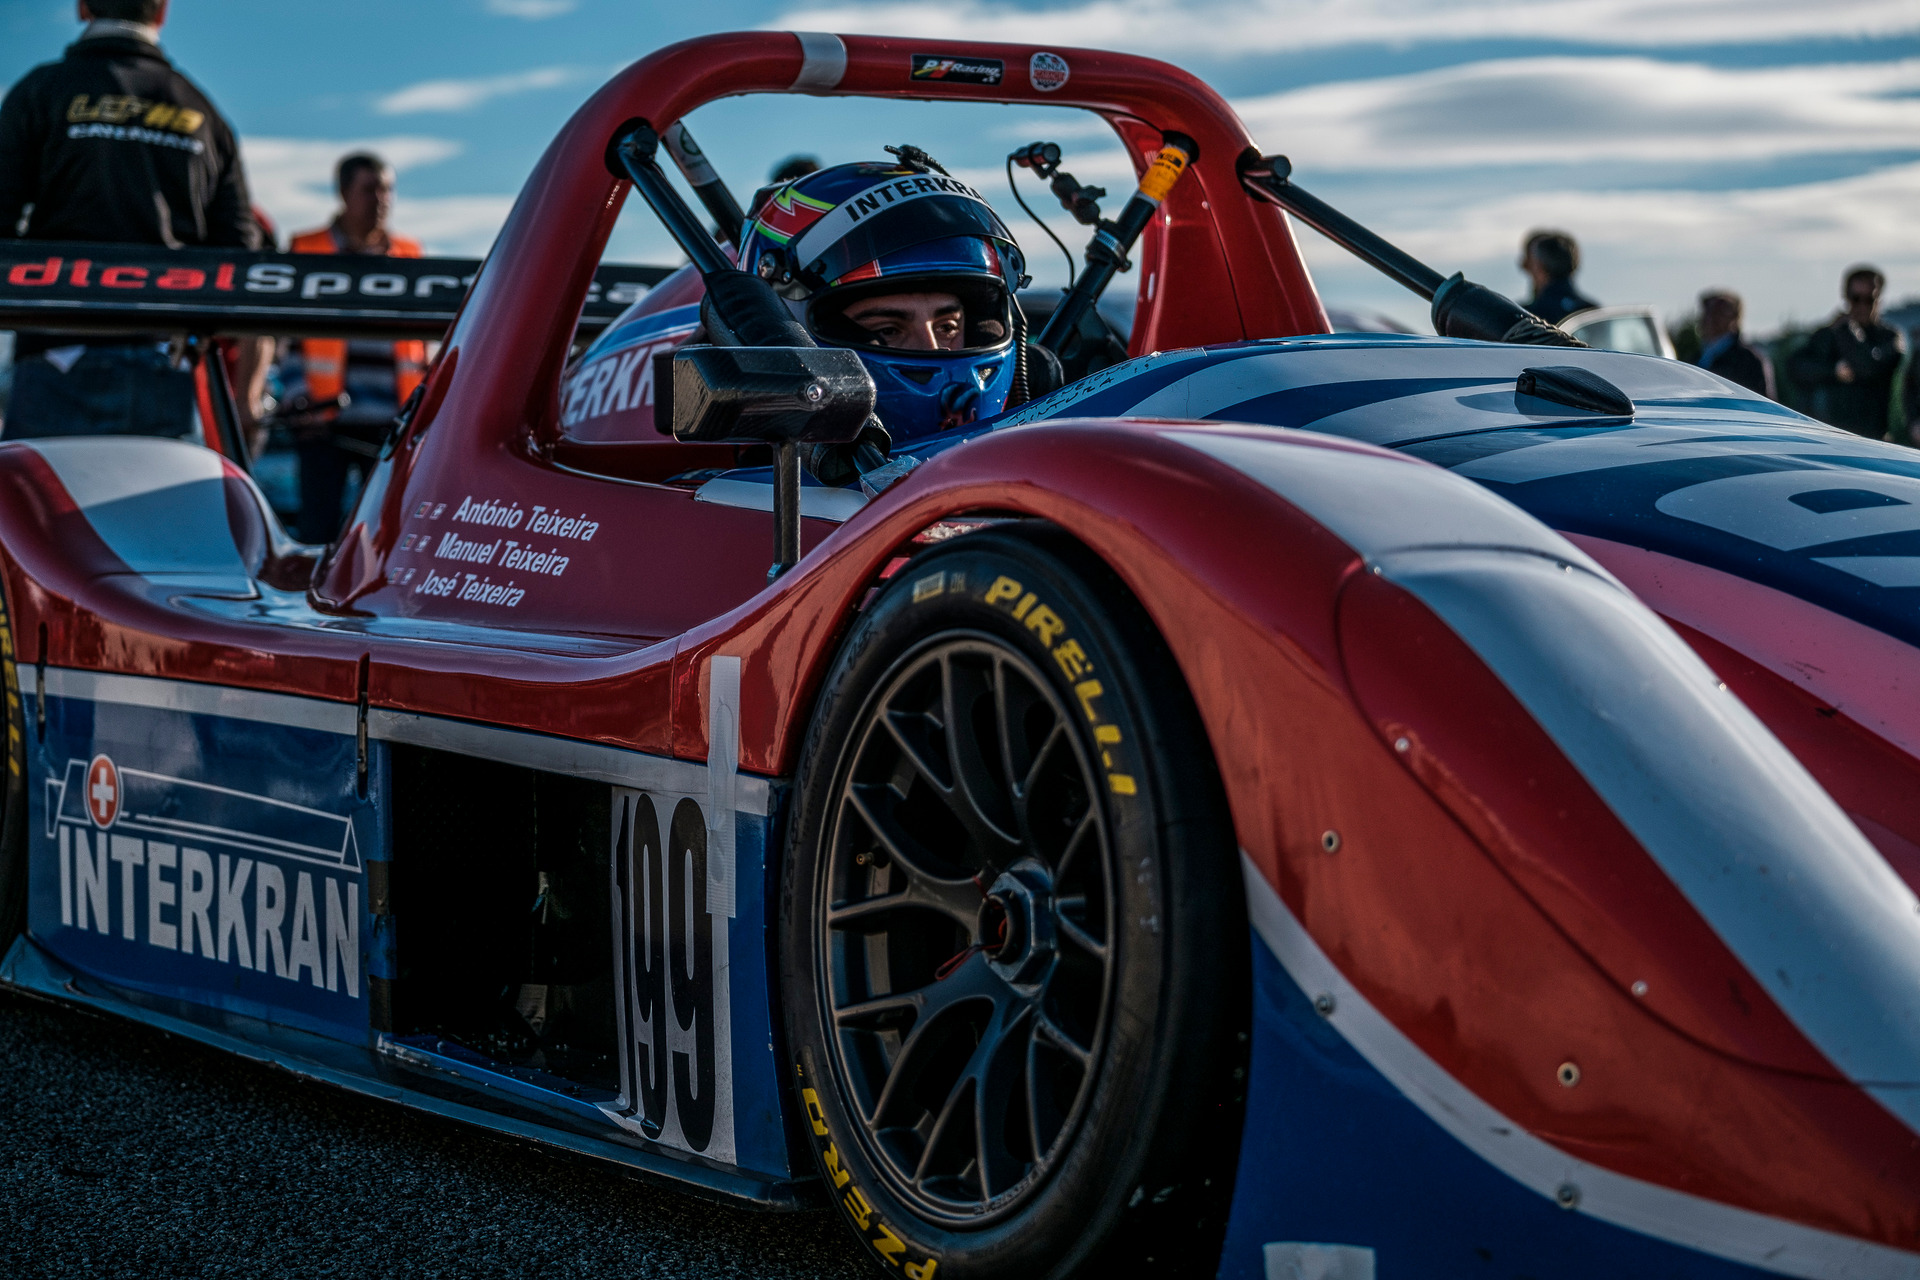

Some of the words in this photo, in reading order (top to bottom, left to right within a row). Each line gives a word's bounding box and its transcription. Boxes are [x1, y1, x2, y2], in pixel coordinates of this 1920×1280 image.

[452, 495, 524, 529] António
[525, 504, 599, 542] Teixeira
[434, 531, 502, 565] Manuel
[498, 540, 570, 577] Teixeira
[415, 568, 462, 597] José
[456, 573, 526, 608] Teixeira
[984, 575, 1137, 796] PIRELLI
[59, 824, 359, 999] INTERKRAN
